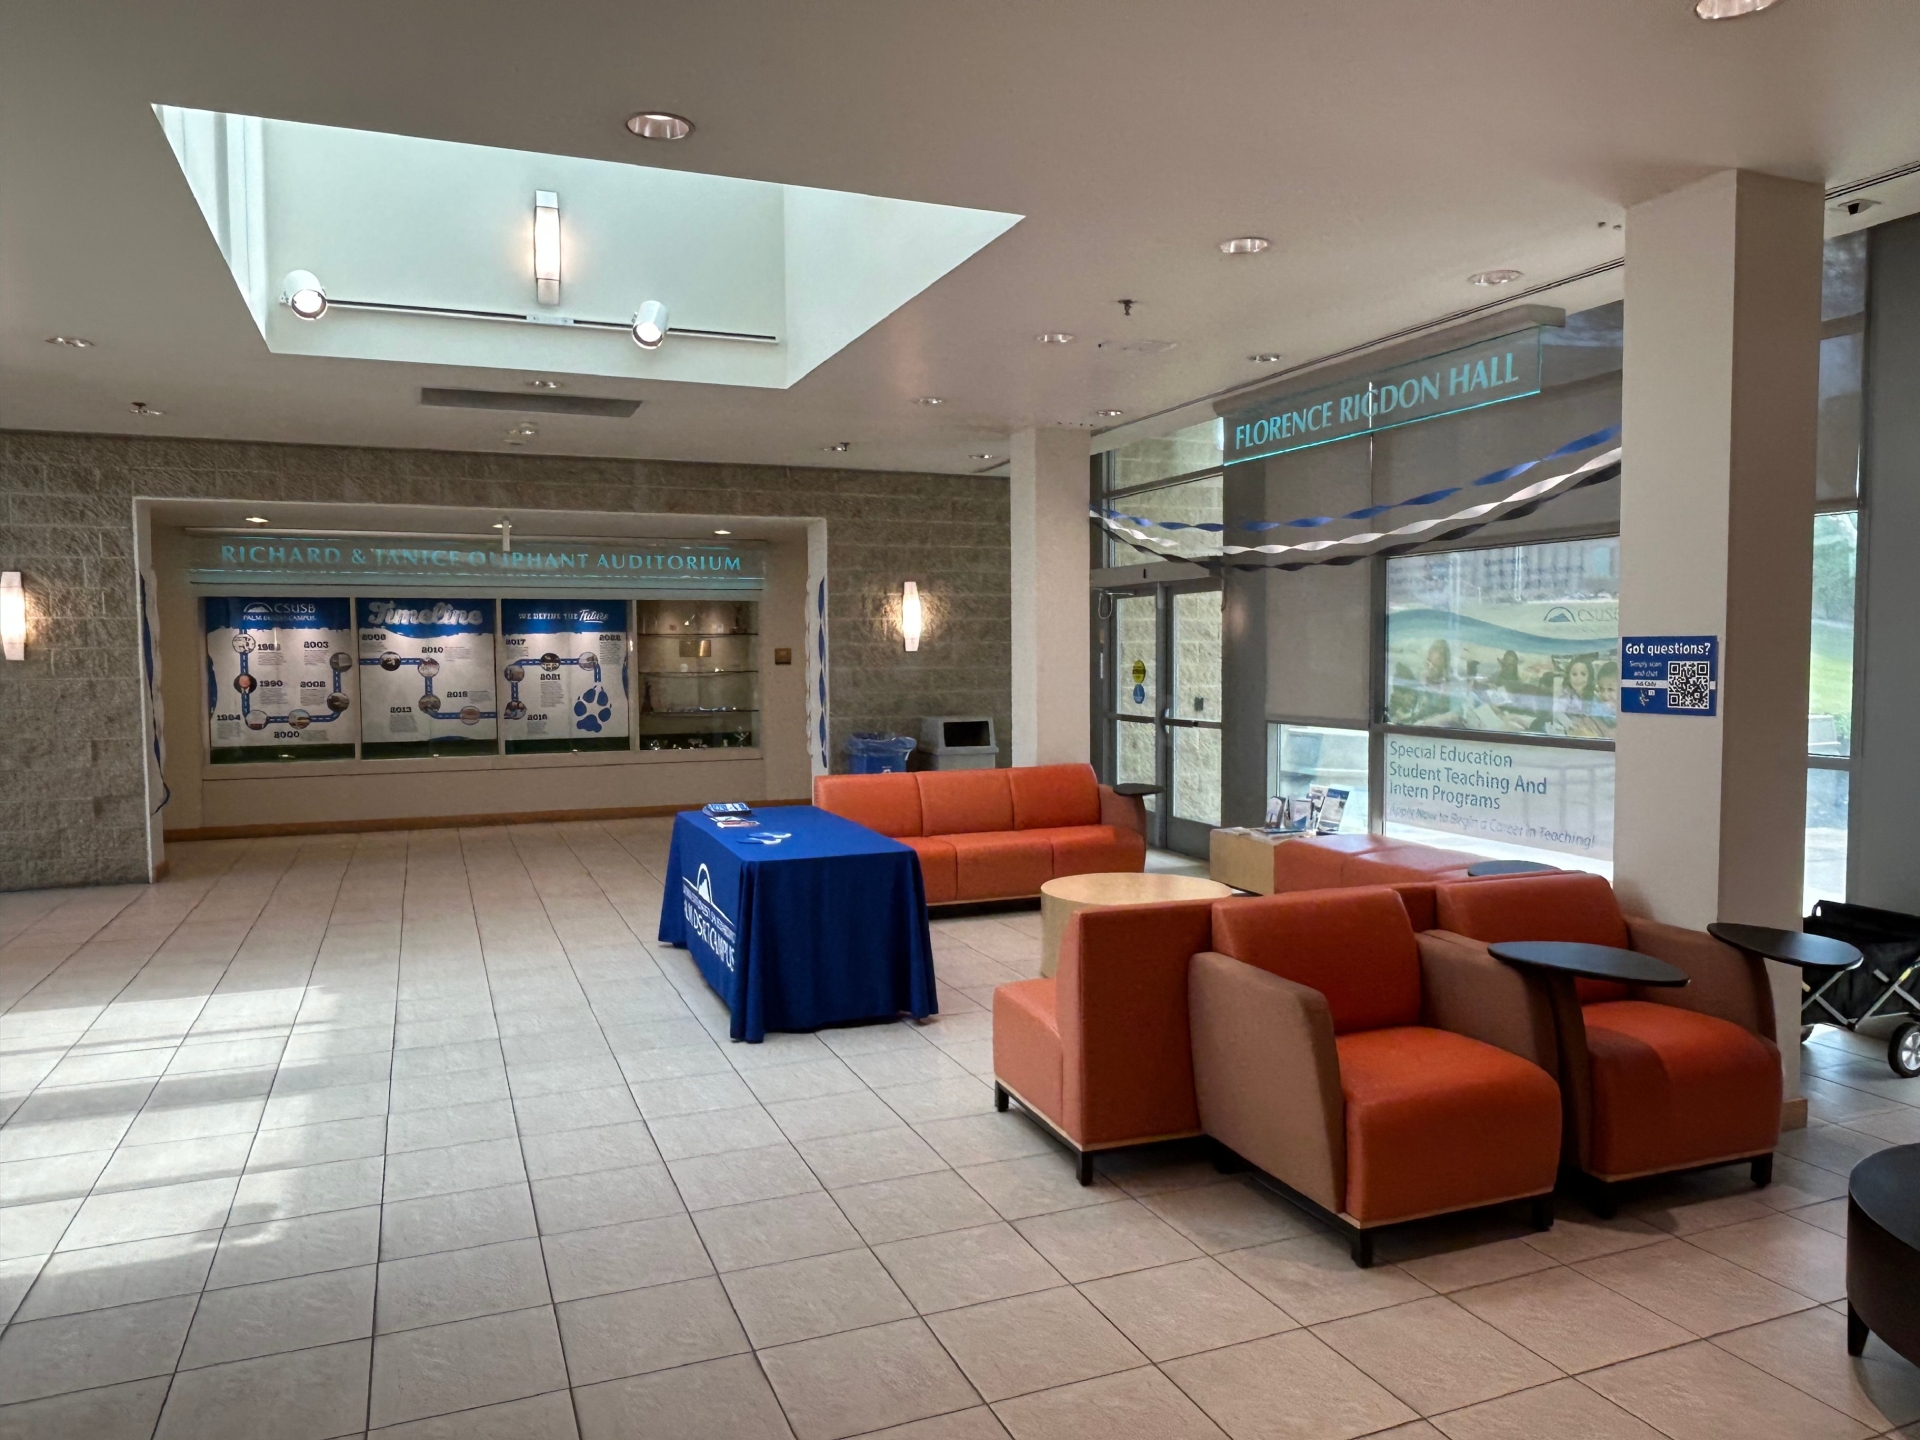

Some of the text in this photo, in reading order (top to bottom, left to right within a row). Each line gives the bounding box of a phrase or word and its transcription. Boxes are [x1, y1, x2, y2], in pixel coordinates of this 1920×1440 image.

[1236, 352, 1519, 450] FLORENCE RIGDON HALL
[221, 545, 341, 564] RICHARD
[352, 548, 366, 565] &
[468, 550, 589, 569] OLIPHANT
[597, 553, 741, 571] AUDITORIUM
[274, 603, 316, 614] CSUSB
[368, 600, 483, 626] Timeline
[1626, 642, 1711, 657] Got questions?
[1629, 660, 1648, 669] Simply
[1390, 740, 1512, 769] Special Education
[1389, 760, 1547, 795] Student Teaching And
[1390, 780, 1501, 810] Intern Programs
[1540, 826, 1596, 850] Teaching!
